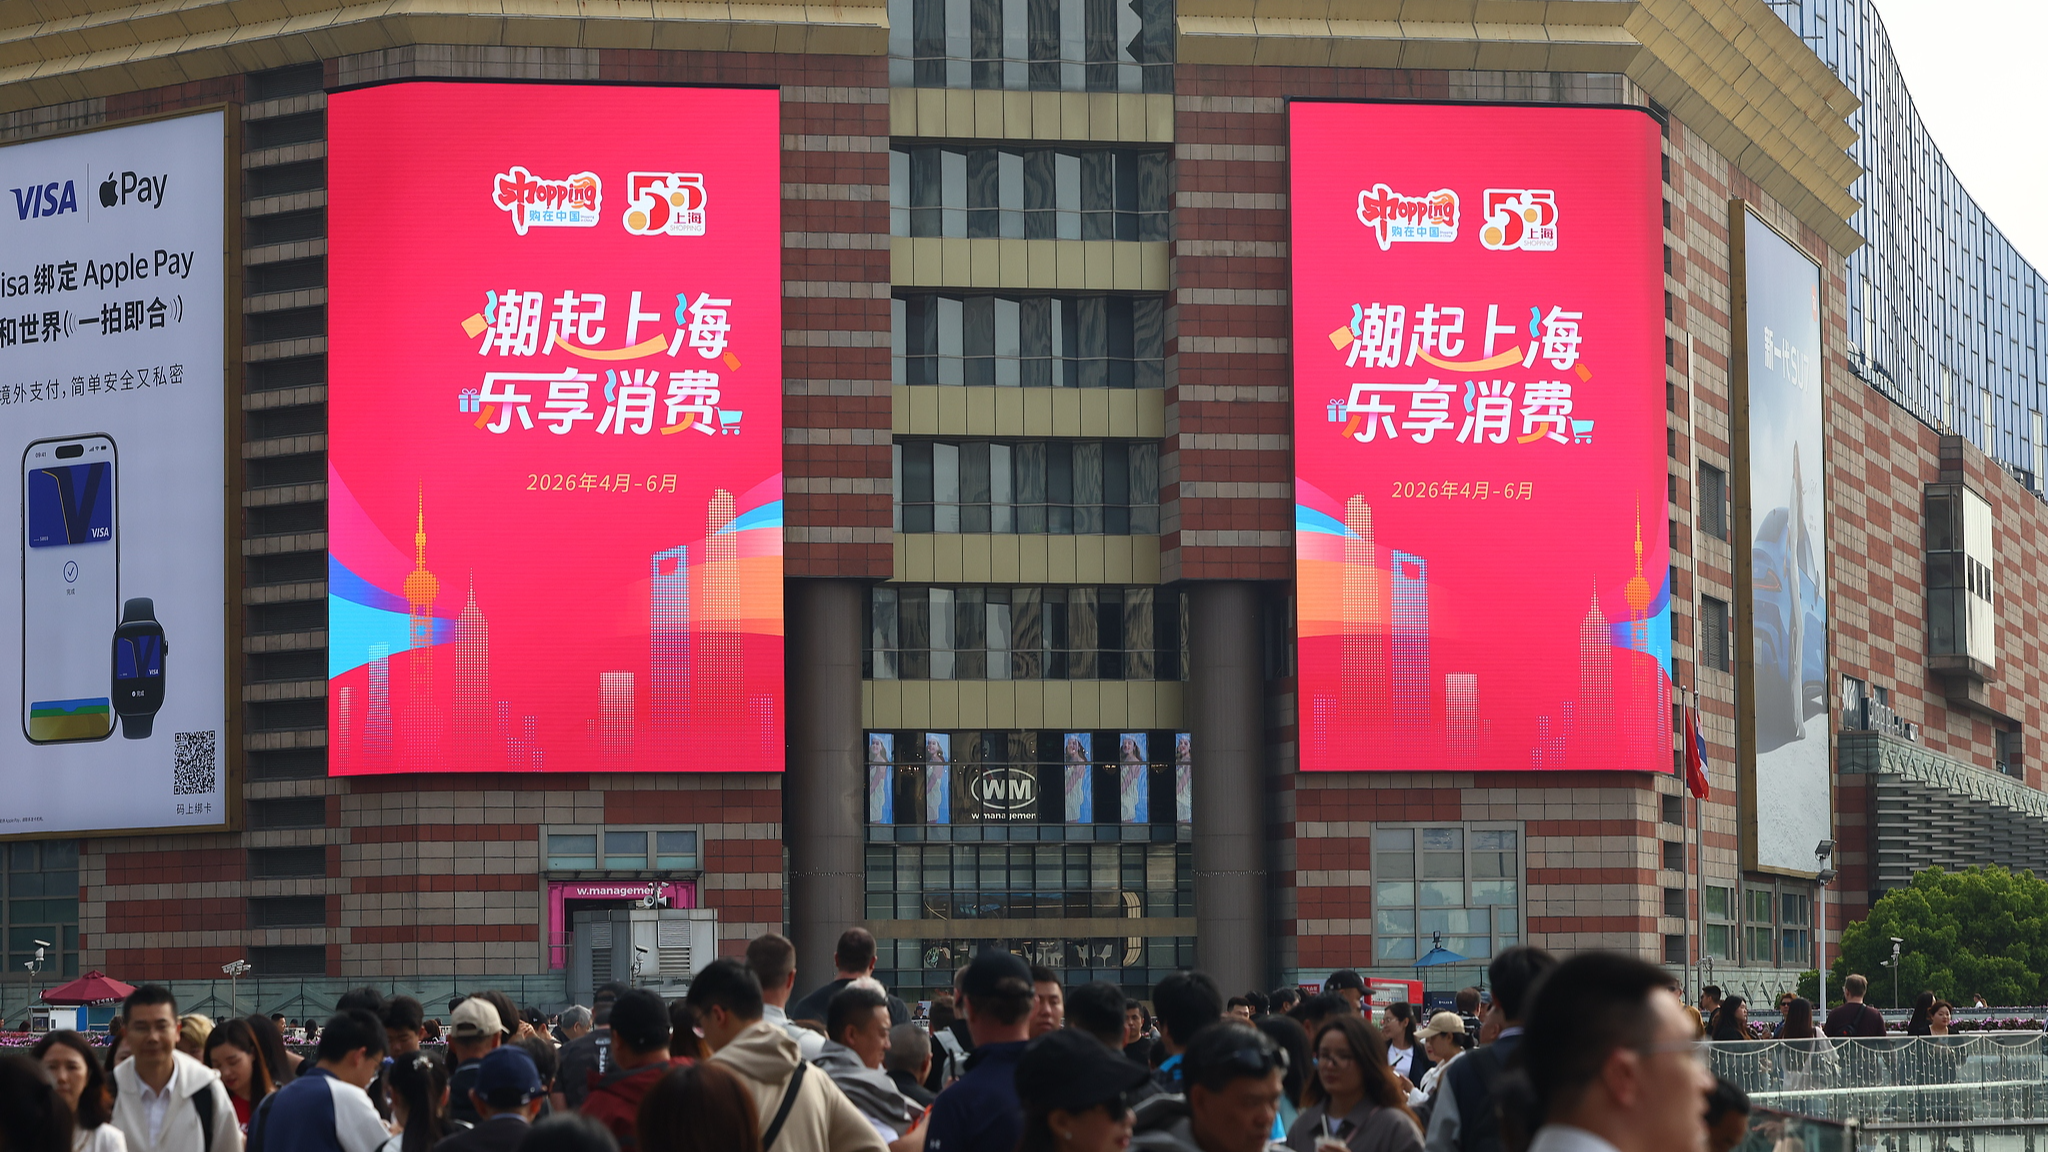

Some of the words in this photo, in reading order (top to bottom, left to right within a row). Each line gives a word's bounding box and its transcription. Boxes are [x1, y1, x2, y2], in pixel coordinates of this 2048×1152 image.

[10, 180, 77, 221] VISA
[121, 171, 168, 209] Pay
[529, 210, 580, 223] 购在中国
[673, 212, 702, 224] 上海
[1391, 226, 1439, 238] 购在中国
[1527, 228, 1554, 240] 上海
[33, 260, 78, 295] 绑定
[83, 253, 149, 290] Apple
[154, 249, 195, 280] Pay
[478, 289, 733, 360] 潮起上海
[1345, 302, 1584, 372] 潮起上海
[473, 366, 720, 436] 乐享消费
[1341, 377, 1573, 445] 乐享消费
[91, 526, 110, 539] VISA
[982, 779, 1032, 800] WM
[176, 802, 212, 816] 码上绑卡
